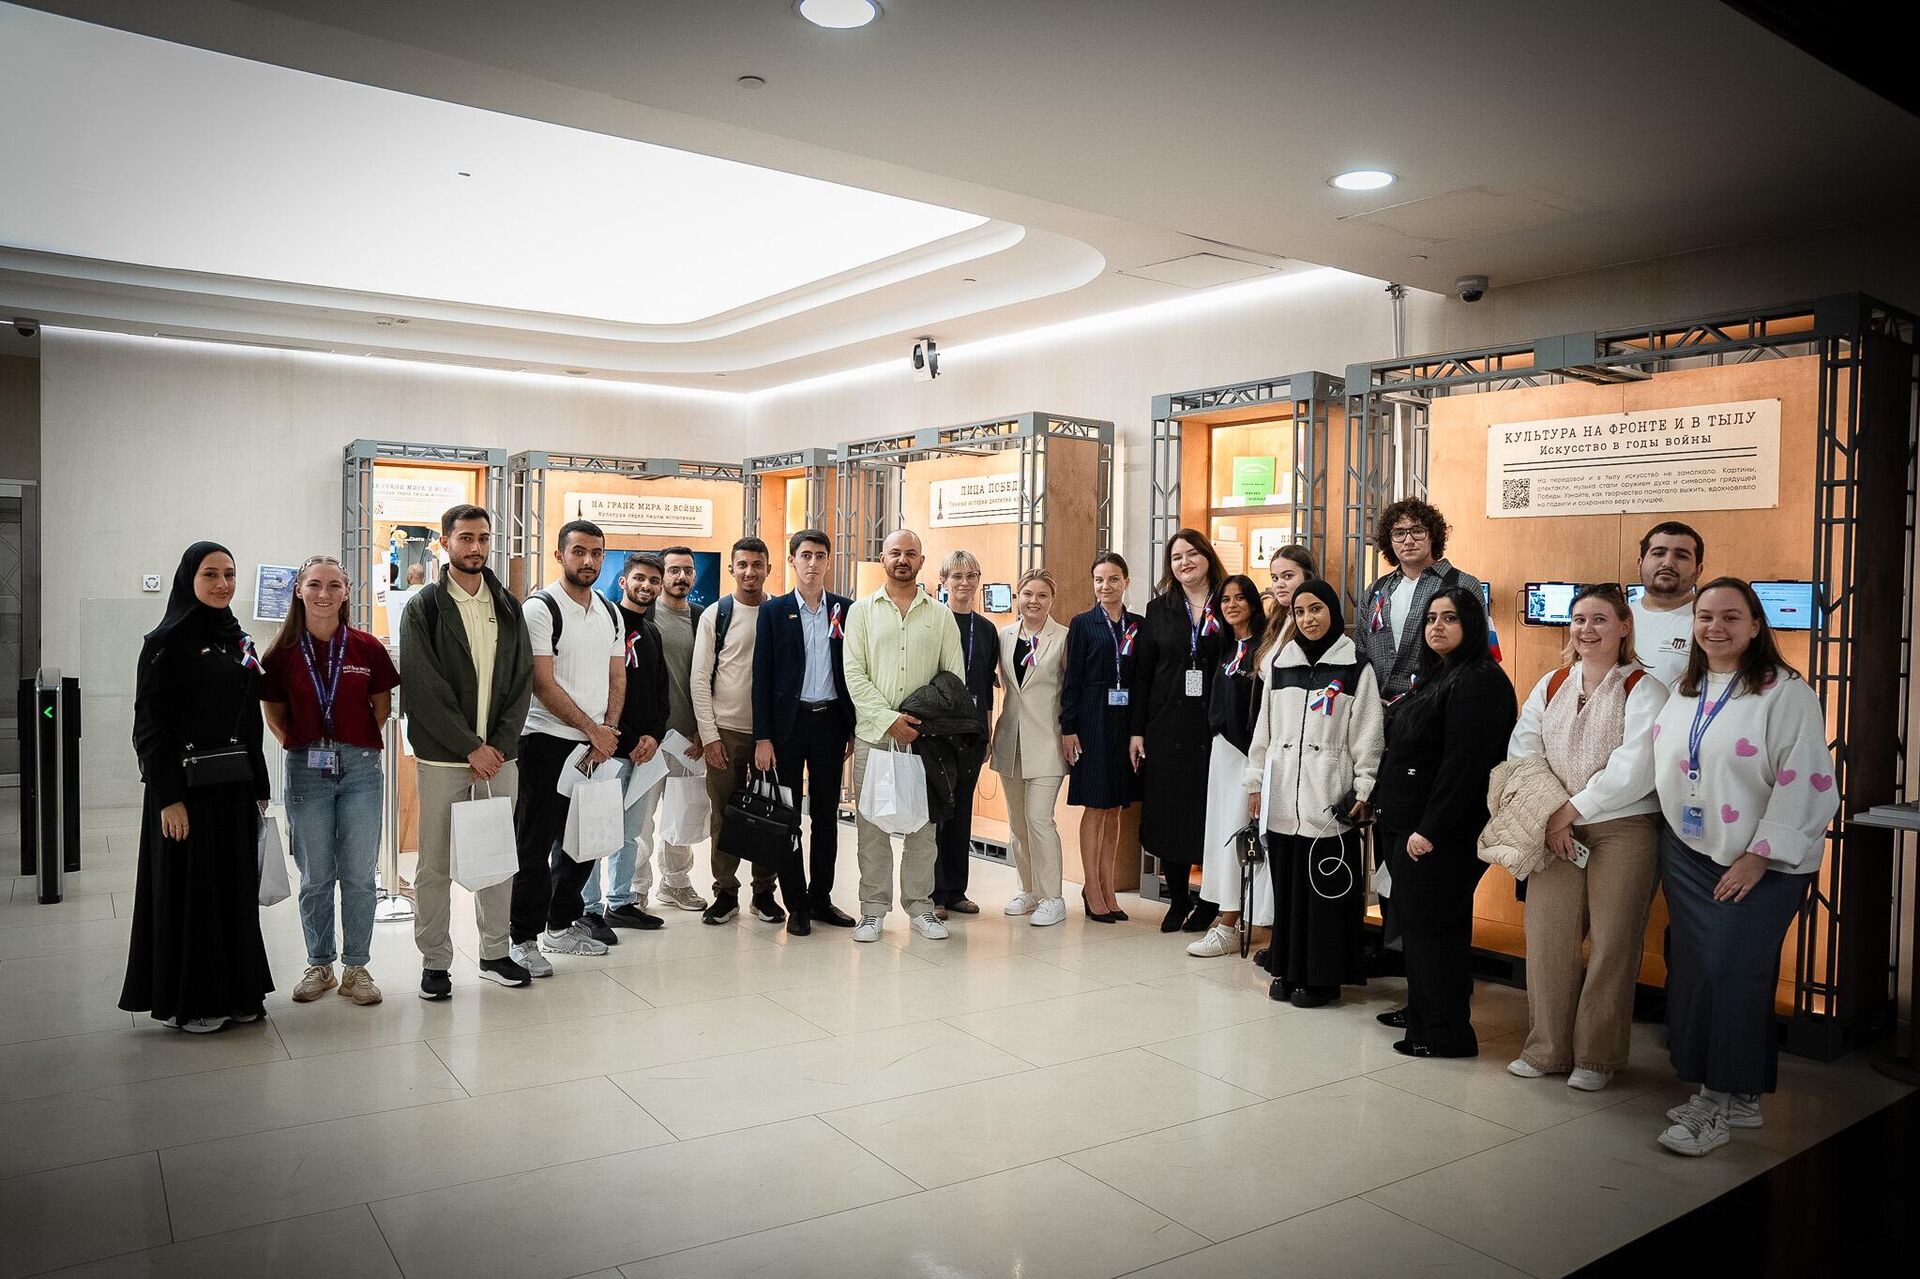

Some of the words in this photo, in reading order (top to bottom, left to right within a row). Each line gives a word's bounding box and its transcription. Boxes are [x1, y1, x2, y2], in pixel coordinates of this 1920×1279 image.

[1505, 428, 1577, 443] КУЛЬТУРА
[1583, 425, 1602, 437] НА
[1609, 419, 1667, 435] ФРОНТЕ
[1674, 418, 1684, 430] И
[1691, 416, 1700, 429] В
[1707, 411, 1756, 427] ТЫЛУ
[1540, 442, 1607, 456] Искусство
[1613, 441, 1620, 450] в
[1626, 439, 1659, 449] годы
[1665, 434, 1712, 446] войны
[1550, 475, 1585, 484] передовой
[1624, 472, 1659, 480] искусство
[1722, 467, 1757, 475] Картины,
[1620, 480, 1651, 489] оружием
[1653, 479, 1670, 487] духа
[1680, 477, 1717, 485] символом
[1719, 474, 1757, 483] грядущей
[961, 484, 985, 496] ЛИЦА
[988, 480, 1019, 493] ПОБЕД
[1605, 489, 1643, 497] творчество
[1644, 487, 1678, 495] помогало
[1680, 486, 1707, 494] выжить,
[1708, 483, 1757, 493] вдохновляло
[592, 500, 604, 509] НА
[607, 501, 635, 510] ГРАНИ
[638, 503, 661, 511] МИРА
[673, 504, 703, 513] ВОЙНЫ
[1578, 498, 1613, 506] сохраняло
[1614, 498, 1630, 506] веру
[1637, 496, 1665, 505] лучшее.
